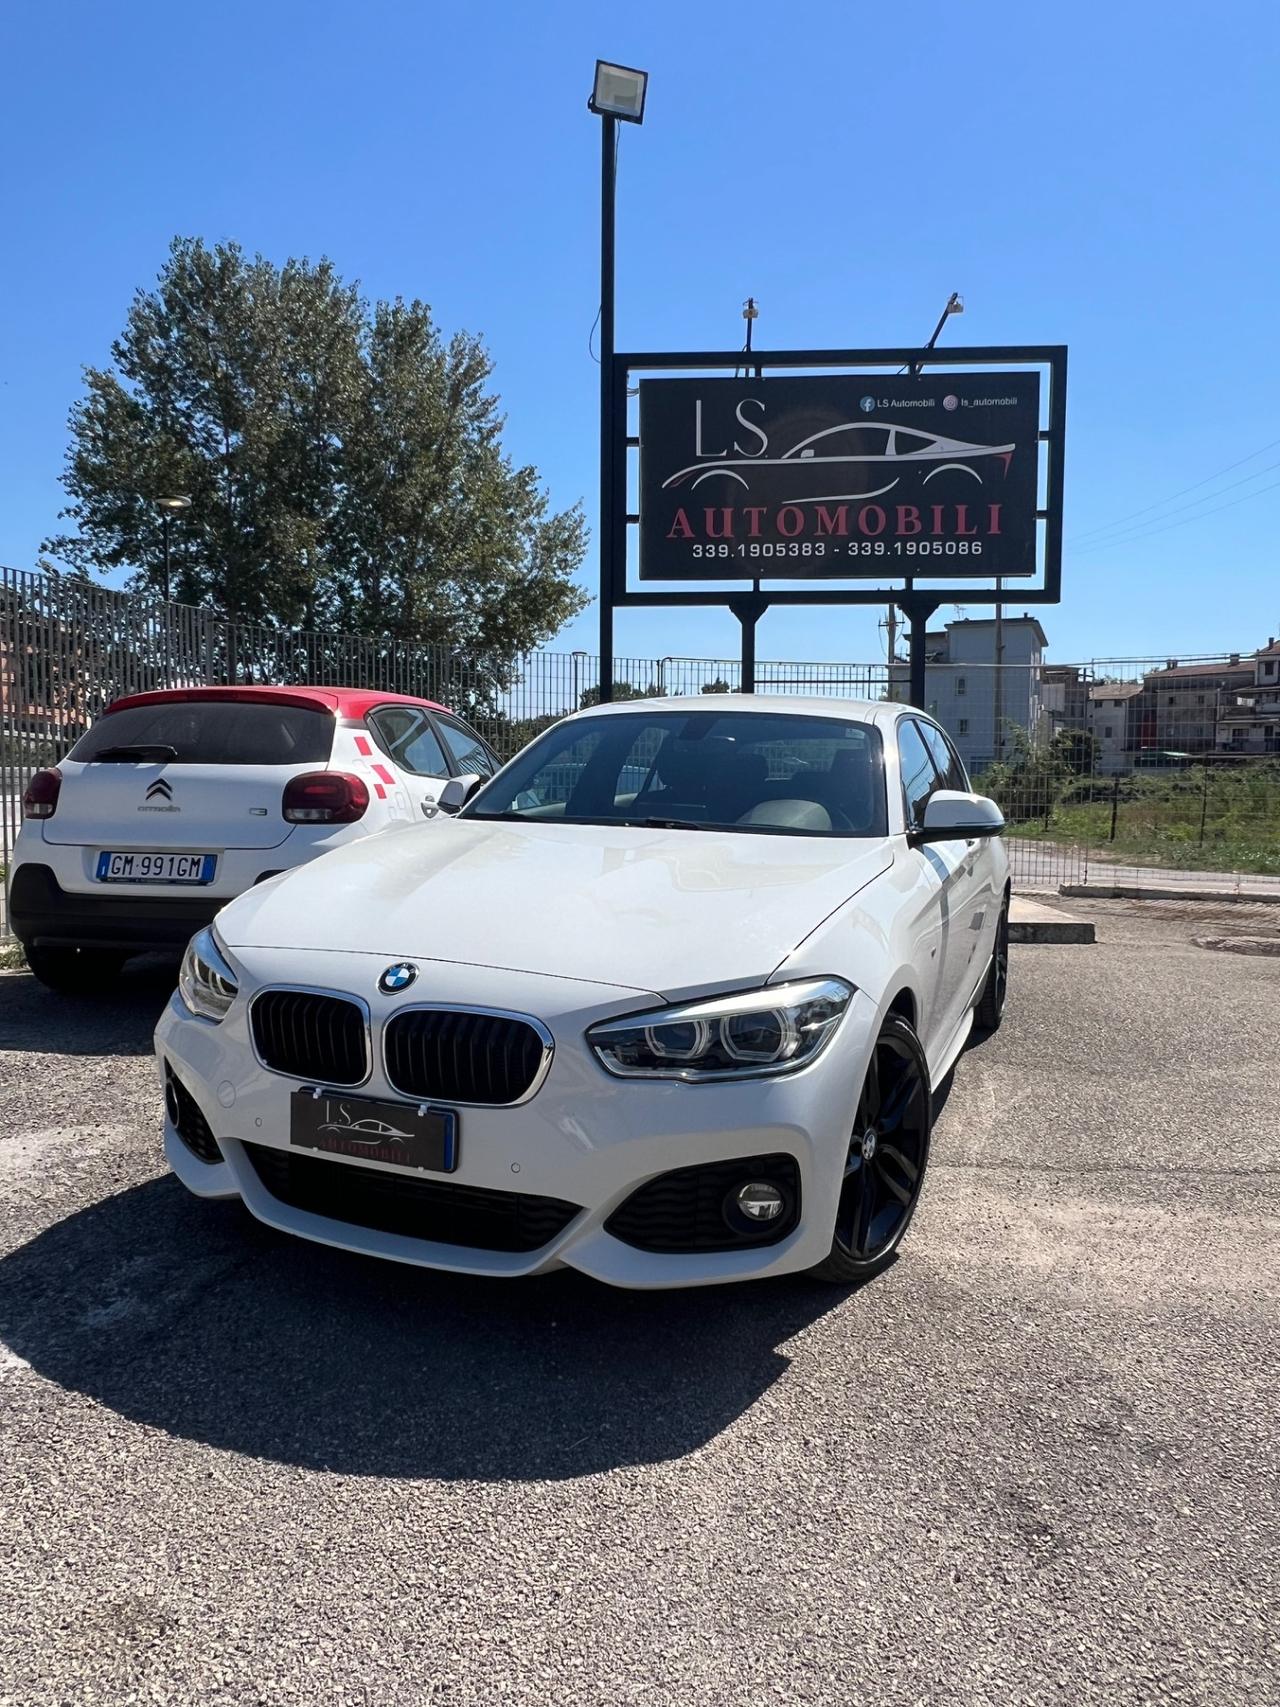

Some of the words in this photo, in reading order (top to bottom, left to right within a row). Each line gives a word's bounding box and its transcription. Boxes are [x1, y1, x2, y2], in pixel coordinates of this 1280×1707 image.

[877, 399, 889, 408] LS
[890, 398, 935, 408] Automobili
[695, 398, 769, 458] LS
[665, 503, 1003, 538] AUTOMOBILI
[692, 542, 826, 558] 339.1905383
[847, 541, 983, 557] 339.1905086
